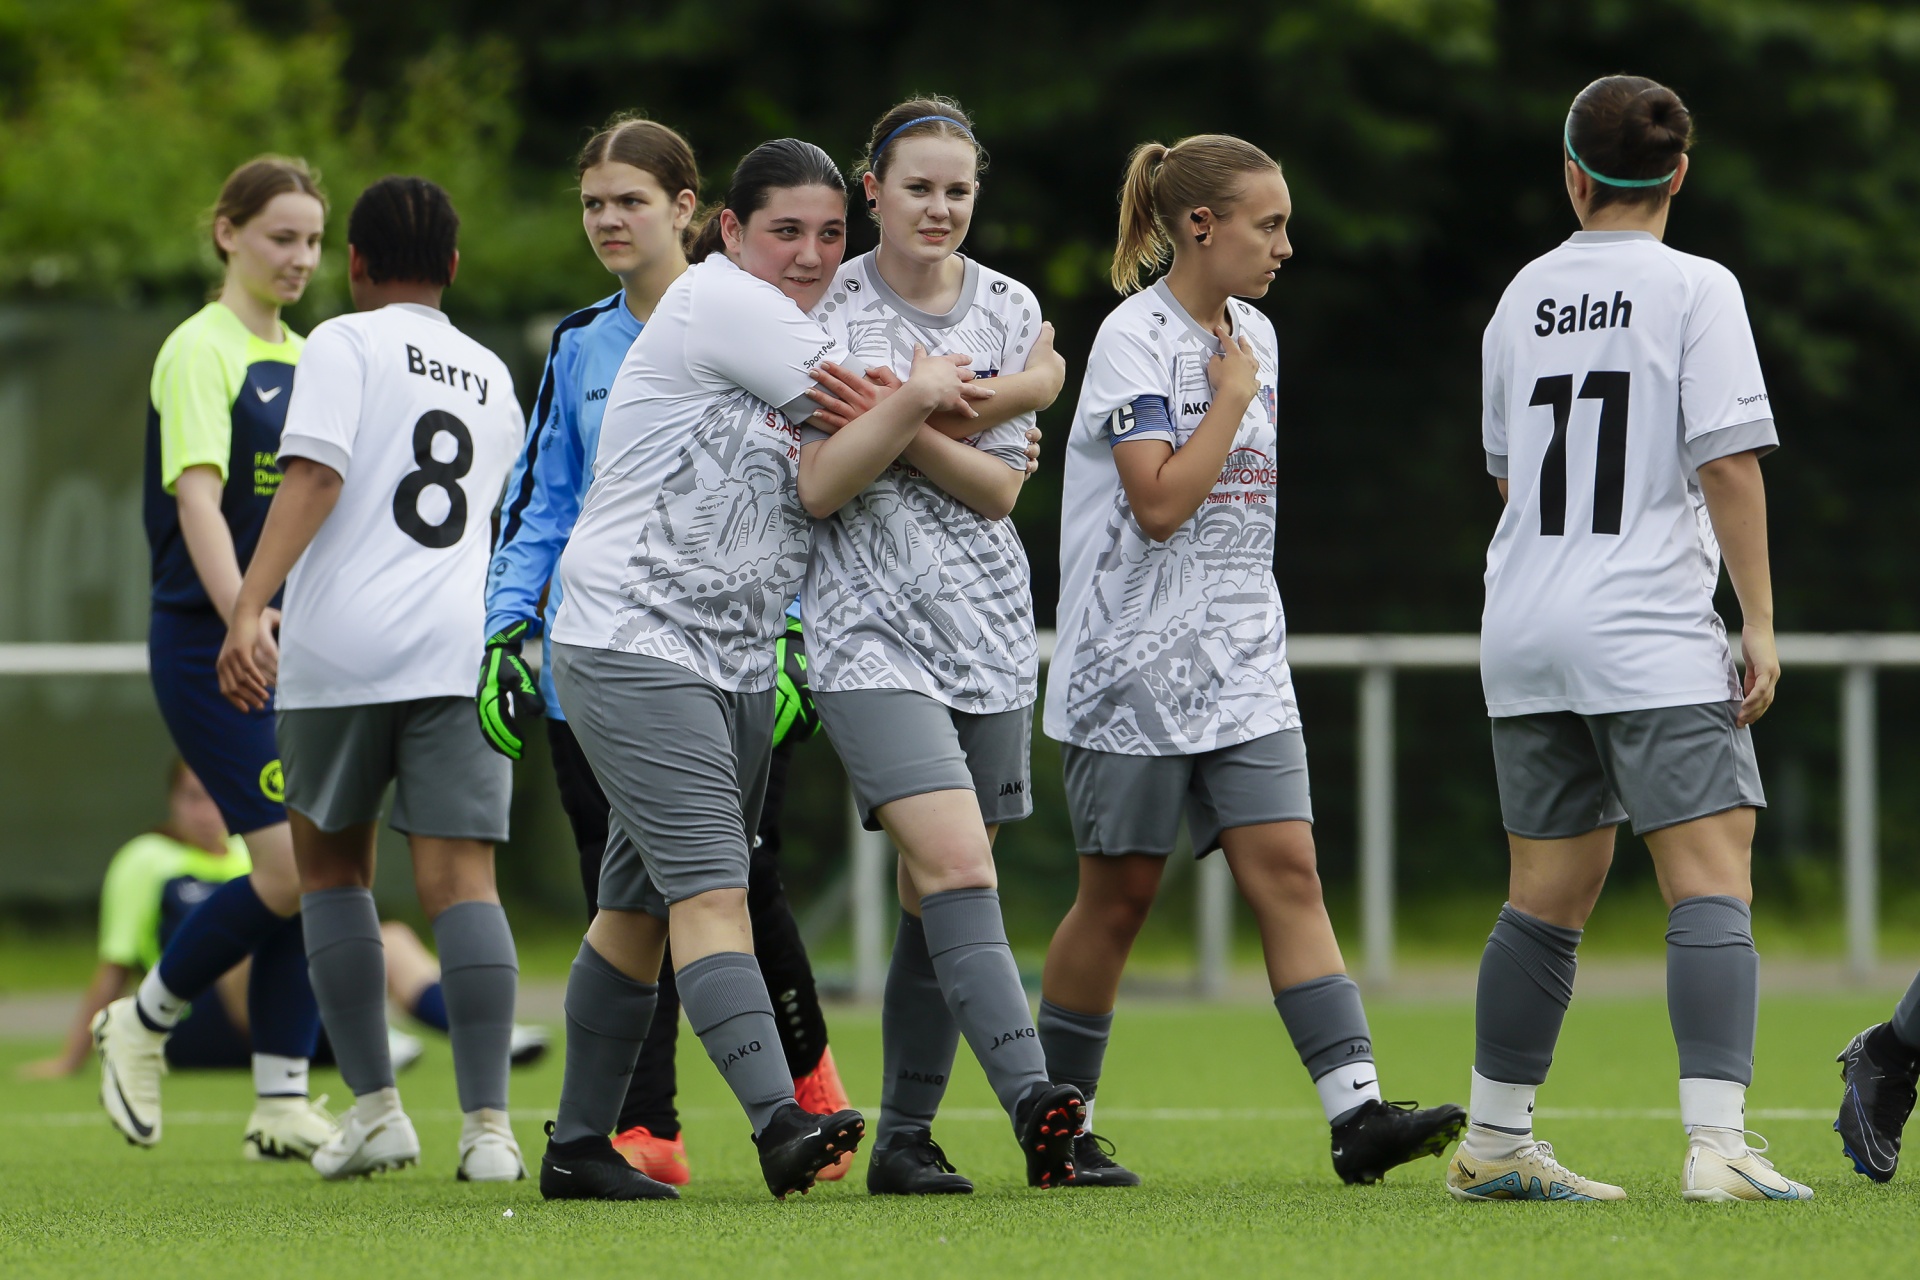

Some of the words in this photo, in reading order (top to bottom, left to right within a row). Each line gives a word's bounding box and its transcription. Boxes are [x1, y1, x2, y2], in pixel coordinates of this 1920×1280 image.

[1534, 290, 1633, 338] Salah
[406, 343, 489, 406] Barry
[803, 350, 825, 370] Sport
[1737, 393, 1763, 406] Sport
[1111, 403, 1136, 437] C
[1528, 370, 1631, 537] 11
[392, 409, 475, 550] 8
[990, 1027, 1036, 1051] JAKO
[721, 1040, 762, 1071] JAKO
[898, 1069, 945, 1086] JAKO
